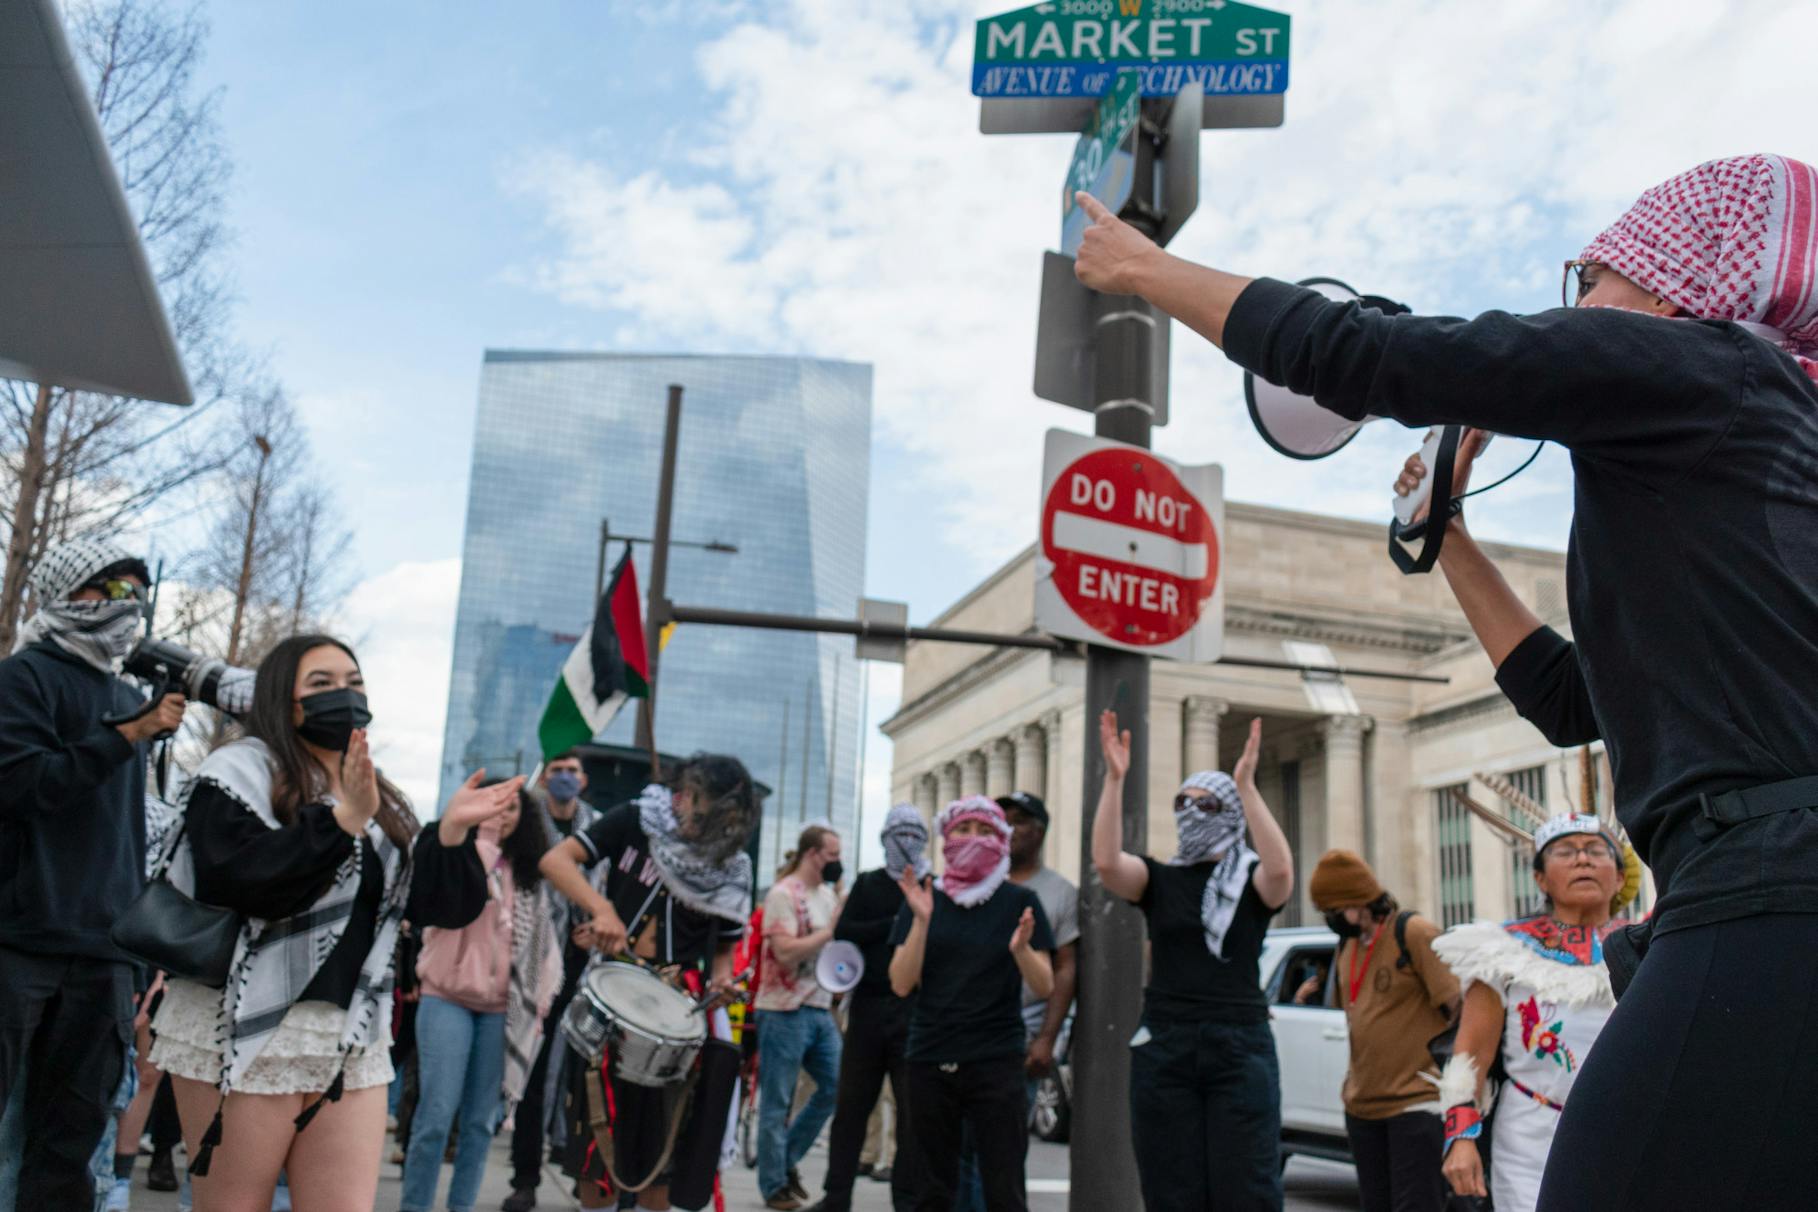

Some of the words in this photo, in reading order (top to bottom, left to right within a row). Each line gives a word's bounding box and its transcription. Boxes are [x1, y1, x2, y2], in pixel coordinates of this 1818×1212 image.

[1060, 0, 1114, 15] 3000
[1119, 0, 1142, 17] W
[986, 18, 1212, 59] MARKET
[1235, 27, 1280, 56] ST
[977, 65, 1077, 95] AVENUE
[1071, 472, 1116, 512] DO
[1134, 488, 1192, 534] NOT
[1078, 564, 1180, 616] ENTER
